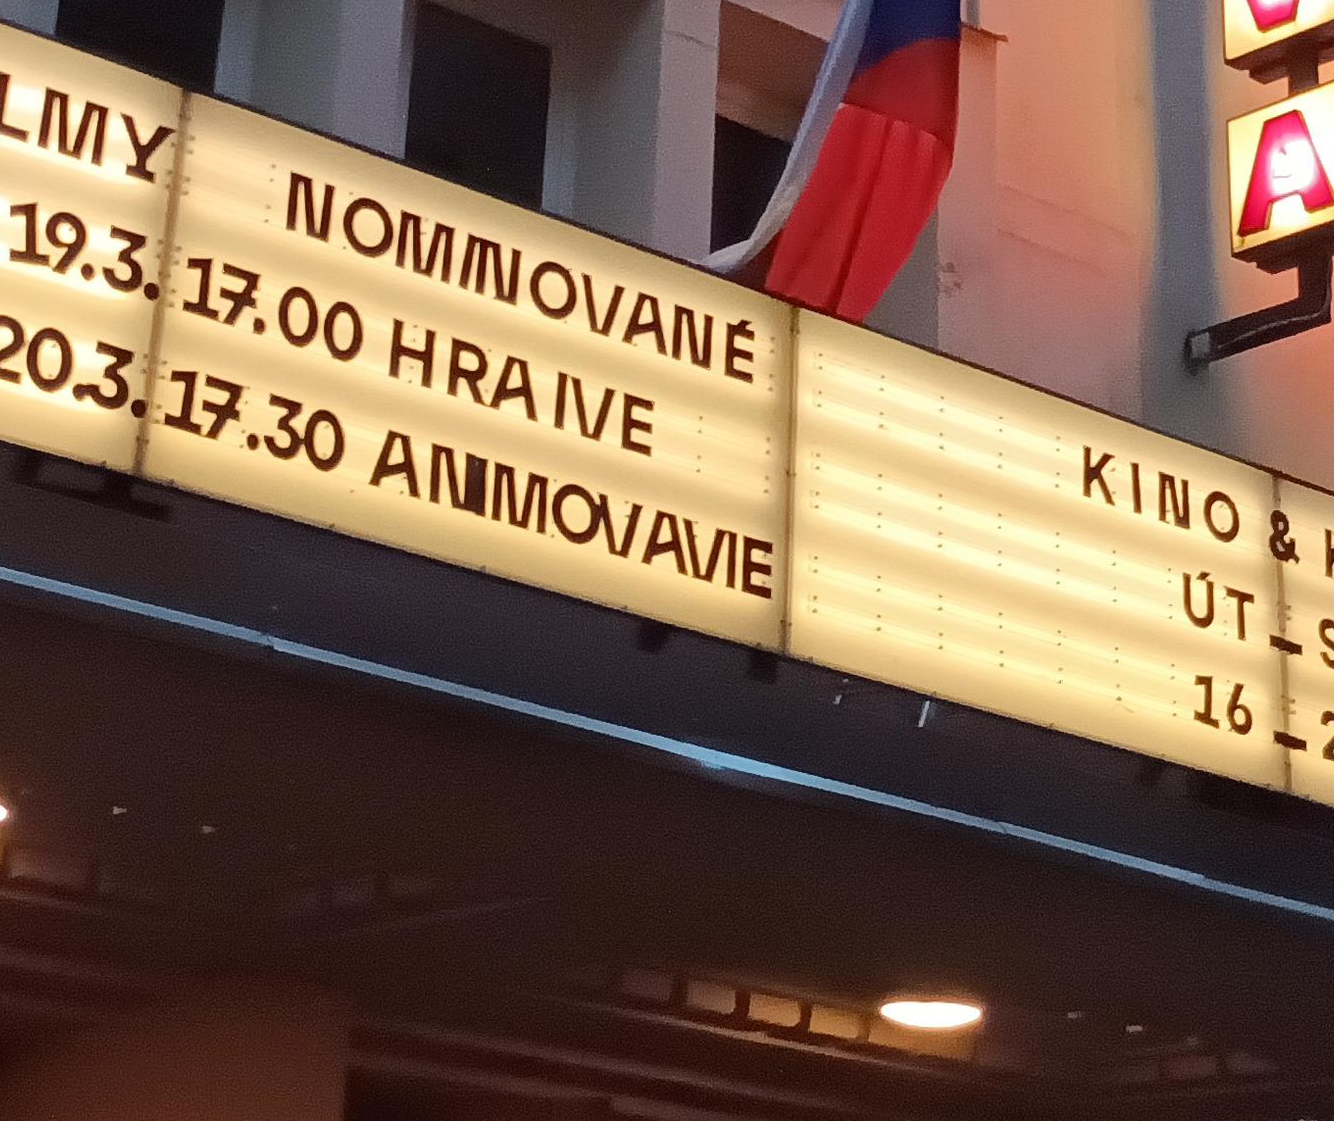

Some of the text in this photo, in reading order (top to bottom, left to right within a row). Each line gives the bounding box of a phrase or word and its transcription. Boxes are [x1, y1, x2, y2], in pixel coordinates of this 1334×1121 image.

[182, 256, 364, 362] 17.00
[164, 368, 347, 472] 17.30
[1082, 445, 1240, 543] KINO
[1269, 510, 1300, 564] &
[1193, 675, 1253, 735] 16
